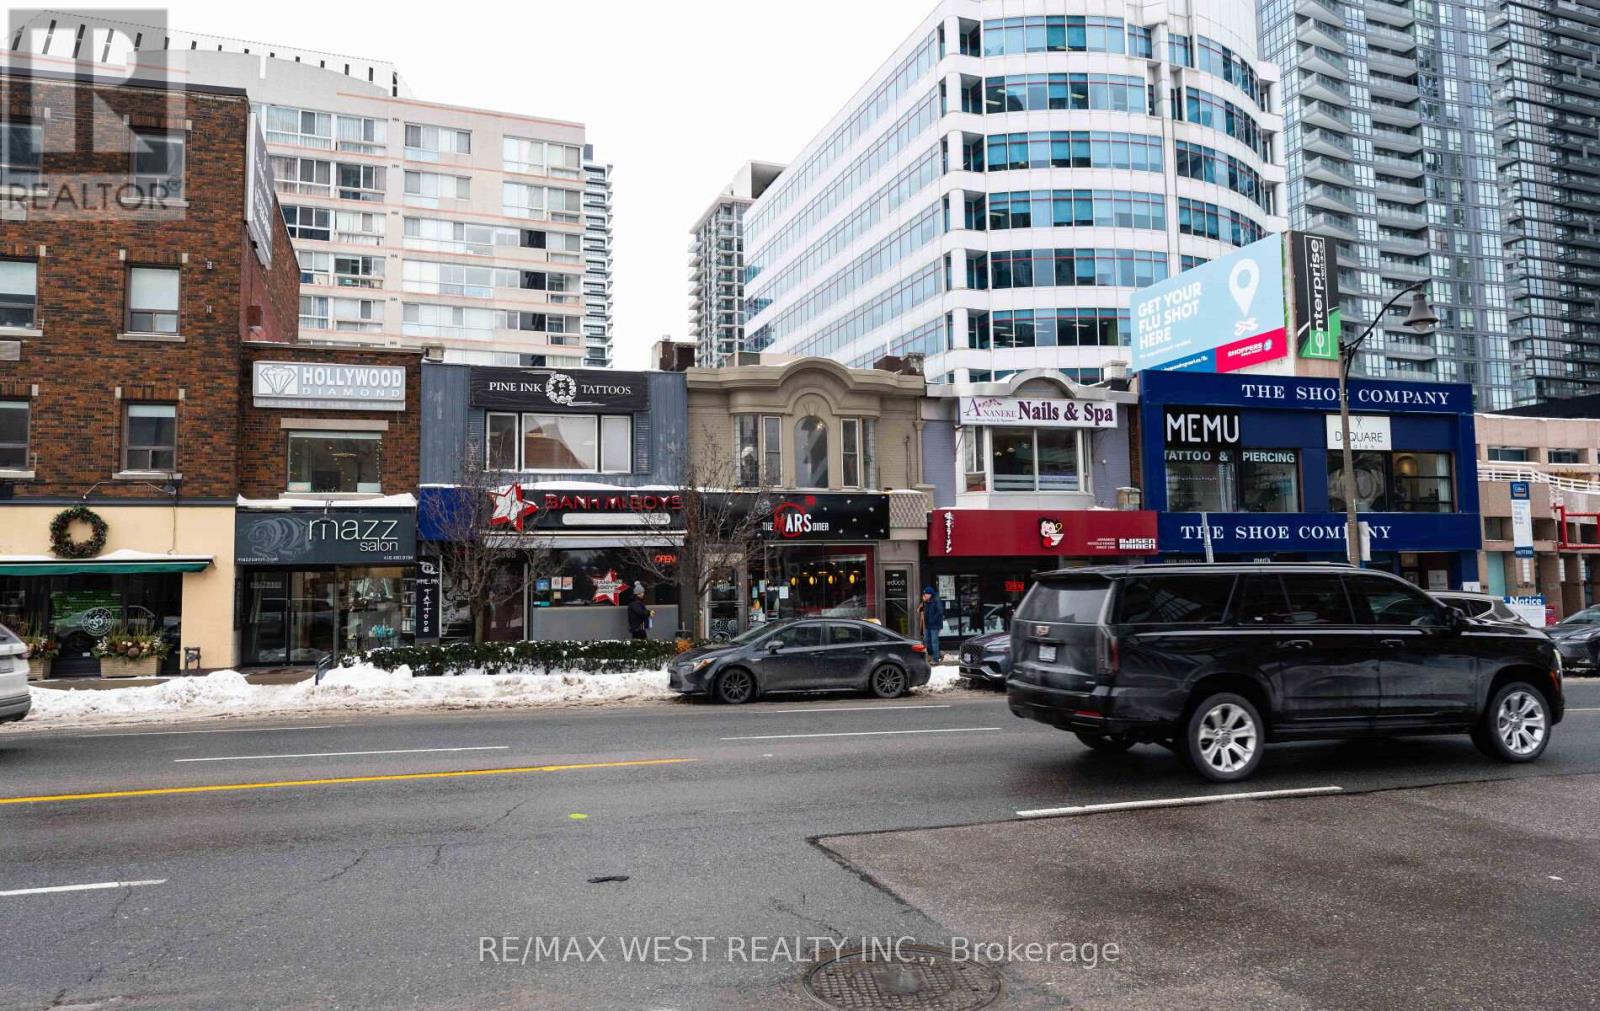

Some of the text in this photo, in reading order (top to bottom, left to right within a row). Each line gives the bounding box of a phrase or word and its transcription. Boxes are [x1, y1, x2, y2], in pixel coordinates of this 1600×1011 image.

[1138, 281, 1202, 317] GET YOUR
[1310, 239, 1325, 349] enterprise
[1139, 300, 1199, 334] FLU SHOT
[1140, 326, 1172, 350] HERE
[302, 367, 402, 387] HOLLYWOOD
[302, 388, 401, 397] DIAMOND
[489, 381, 517, 392] PINE
[520, 382, 543, 393] INK
[581, 384, 632, 395] TATTOOS
[1241, 384, 1285, 399] THE
[1358, 389, 1450, 405] COMPANY
[1018, 400, 1060, 421] Nails
[1063, 402, 1079, 422] &
[1084, 402, 1114, 426] Spa
[1166, 412, 1240, 443] MEMU
[1335, 430, 1383, 443] DQUARE
[1164, 450, 1295, 463] TATTOO & PIERCING
[545, 494, 684, 512] BANH MI BOYS
[309, 518, 399, 541] mazz
[762, 521, 774, 531] THE
[812, 522, 829, 531] DINER
[1235, 526, 1290, 539] SHOE
[1298, 526, 1391, 539] COMNY
[359, 539, 399, 552] salon
[655, 555, 676, 564] OPEN
[1510, 596, 1542, 606] Notice
